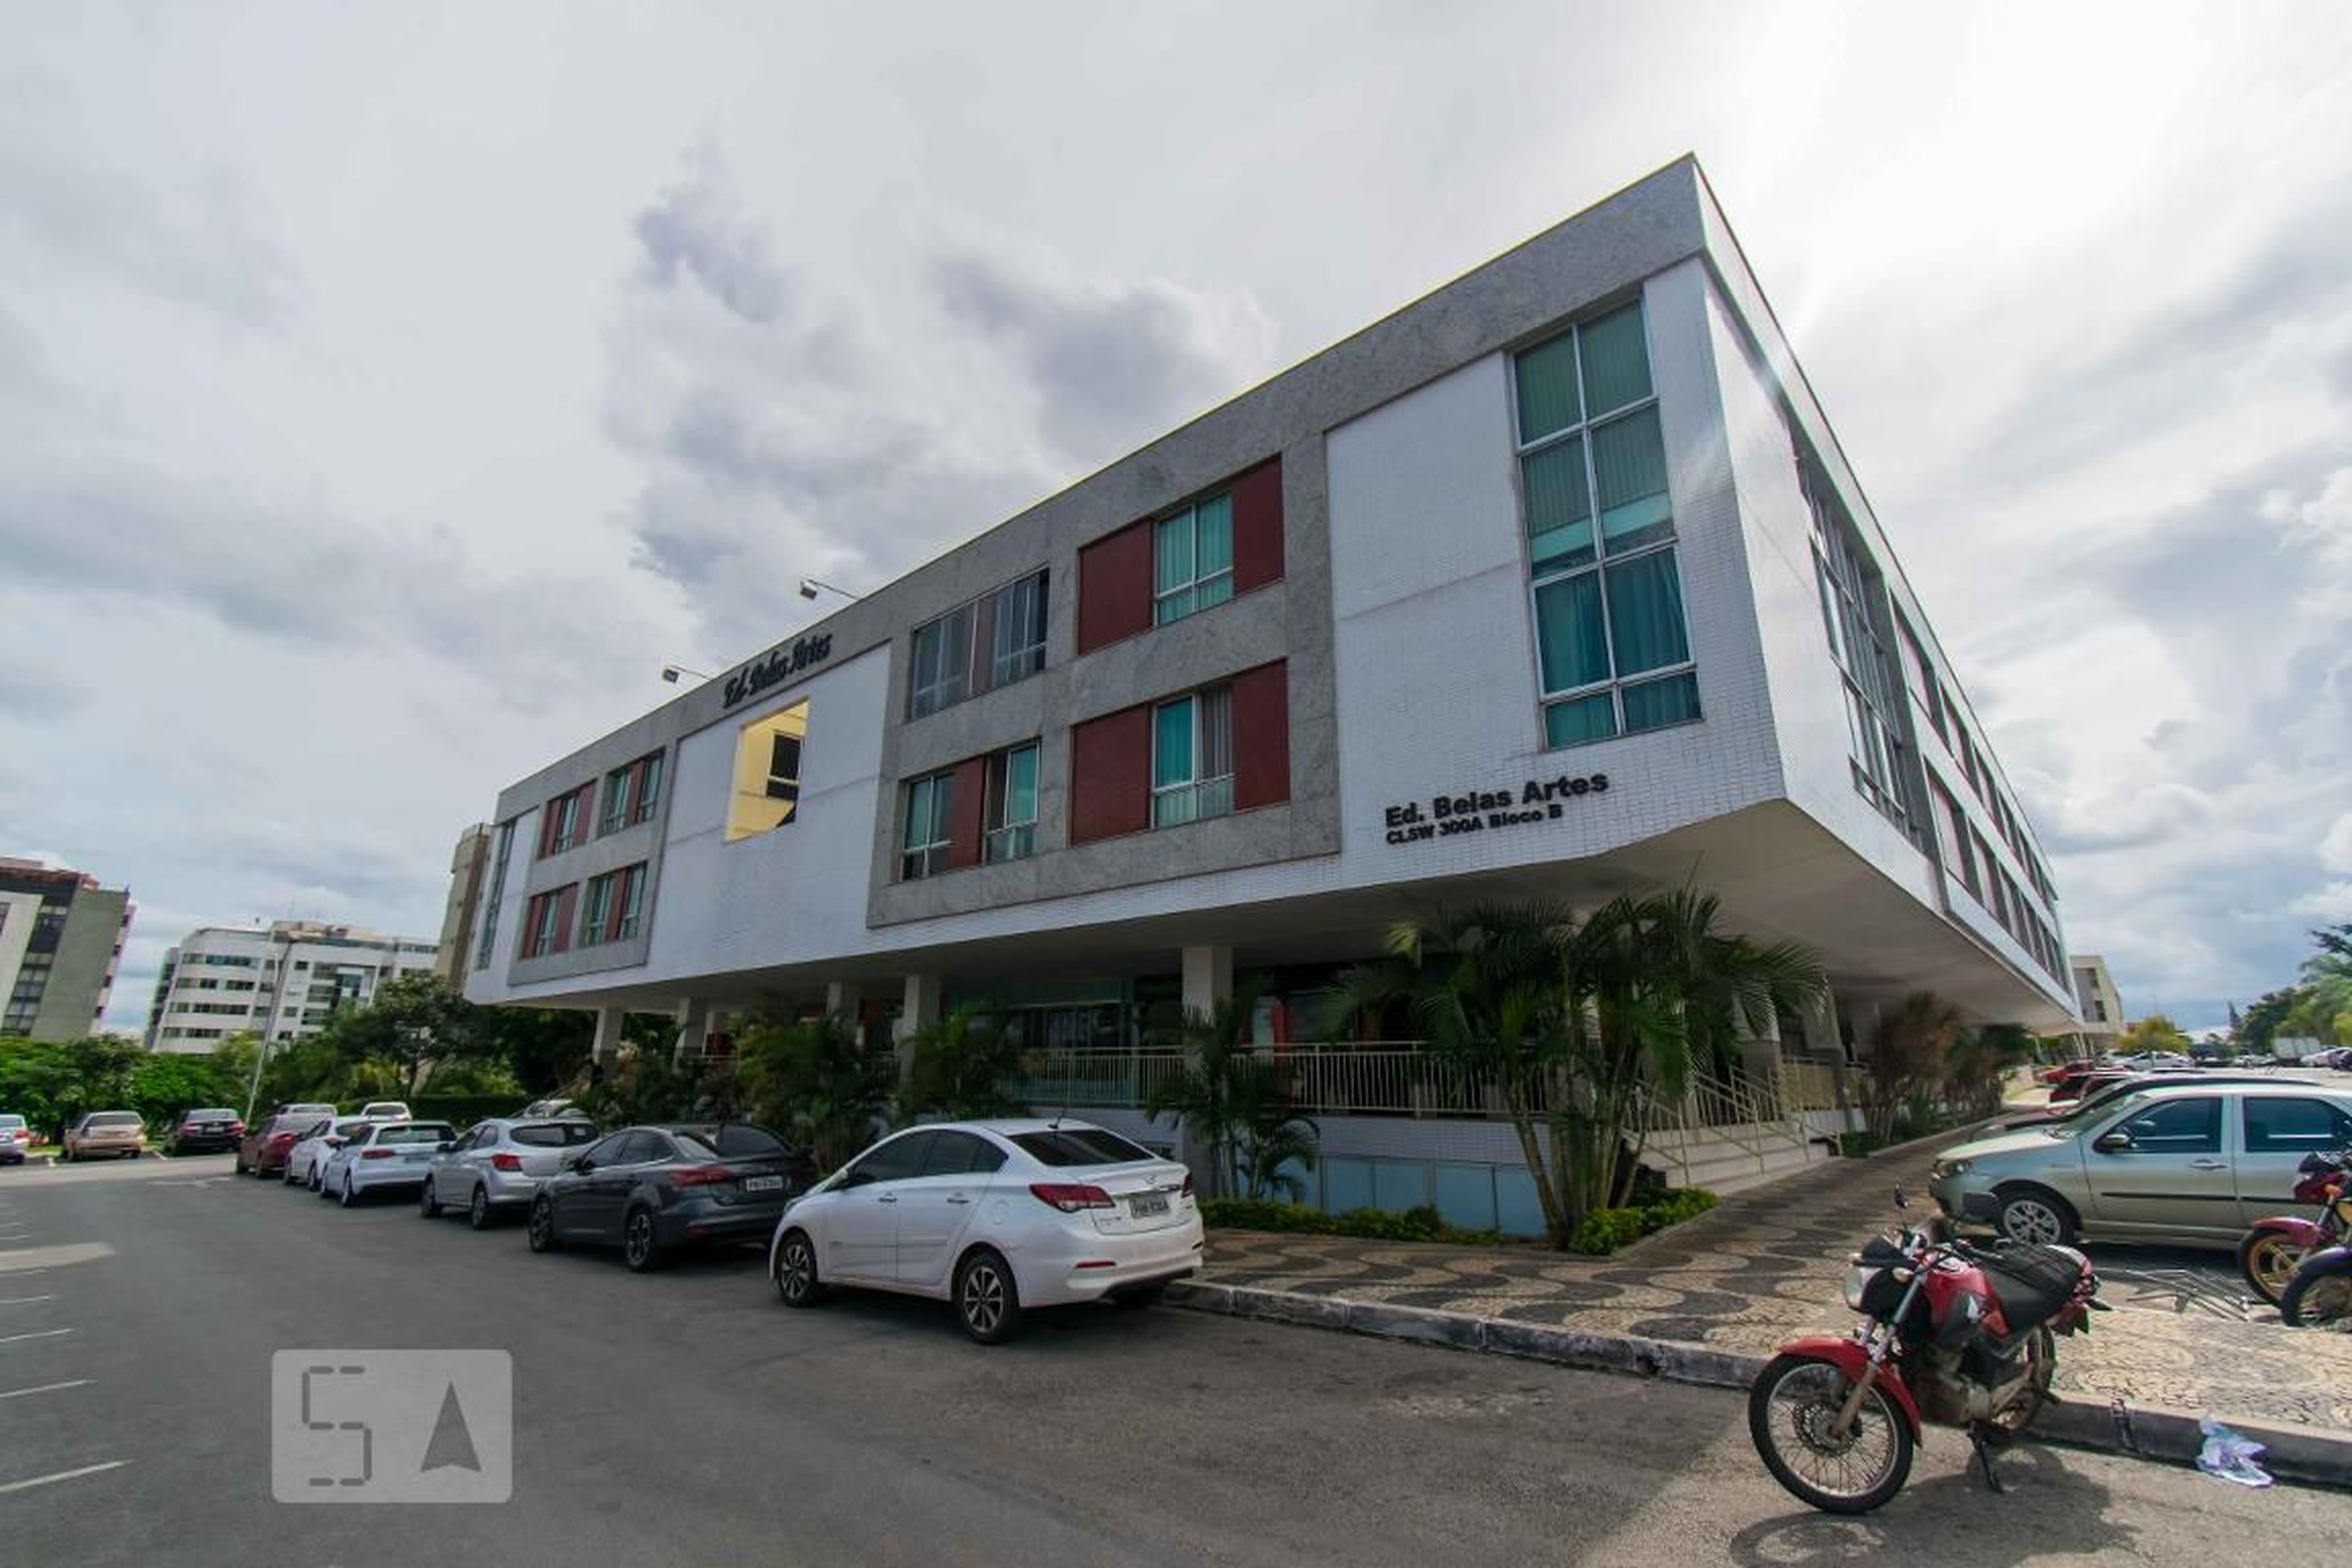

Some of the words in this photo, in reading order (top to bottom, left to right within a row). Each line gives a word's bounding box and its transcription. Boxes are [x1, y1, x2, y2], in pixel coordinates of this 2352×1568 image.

[1385, 802, 1425, 827] Ed.
[1433, 791, 1512, 819] Belas
[1522, 773, 1609, 805] Artes
[1385, 824, 1434, 845] CLSW
[1439, 816, 1485, 836] 300A
[1488, 810, 1543, 827] Bloco
[1548, 804, 1562, 819] B
